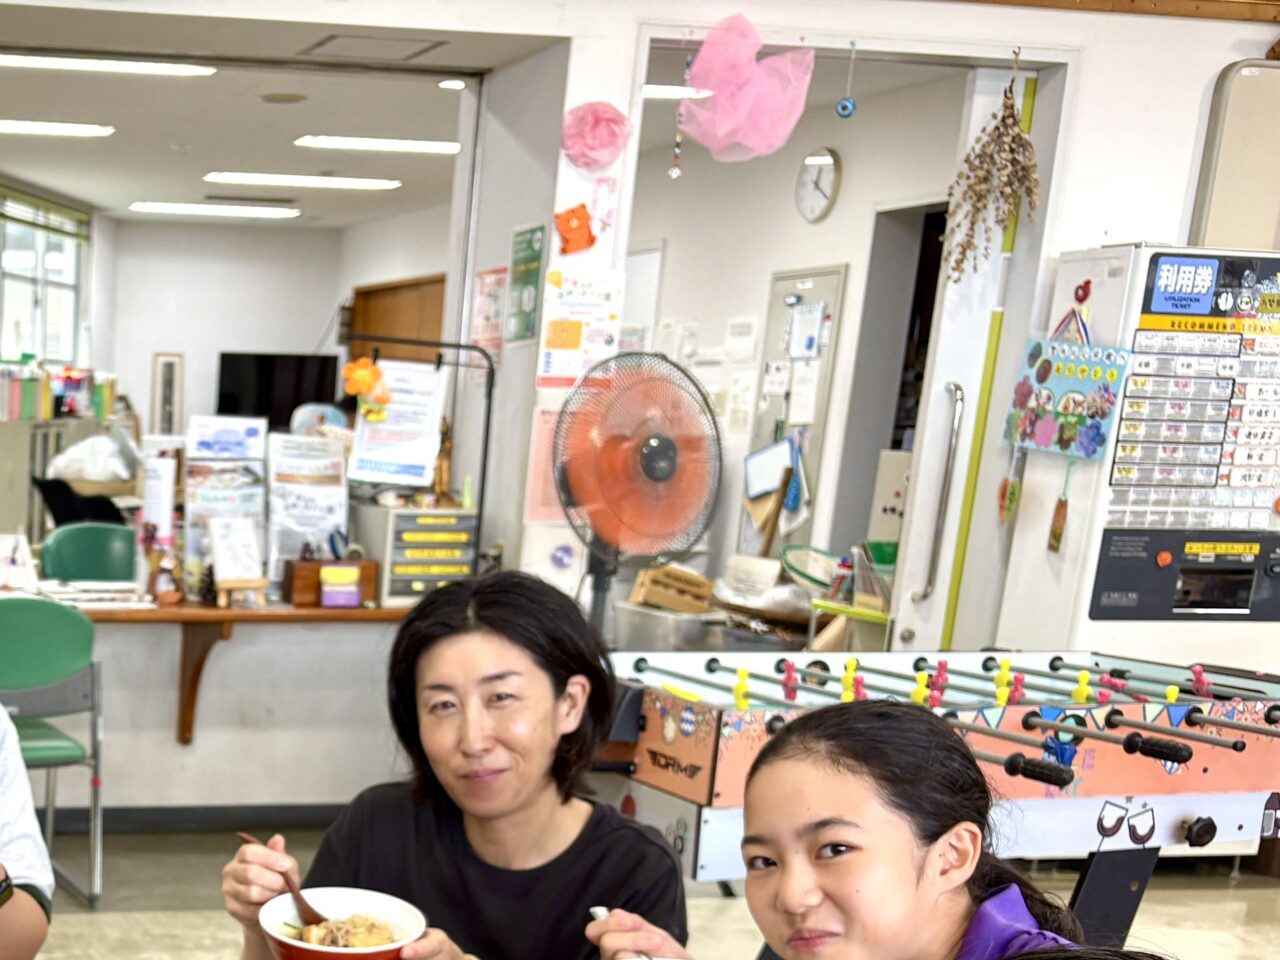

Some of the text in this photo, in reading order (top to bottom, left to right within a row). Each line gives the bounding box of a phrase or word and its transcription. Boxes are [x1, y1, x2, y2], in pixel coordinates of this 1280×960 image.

[1158, 264, 1213, 294] 利用券
[1170, 320, 1236, 331] RECOMMEND
